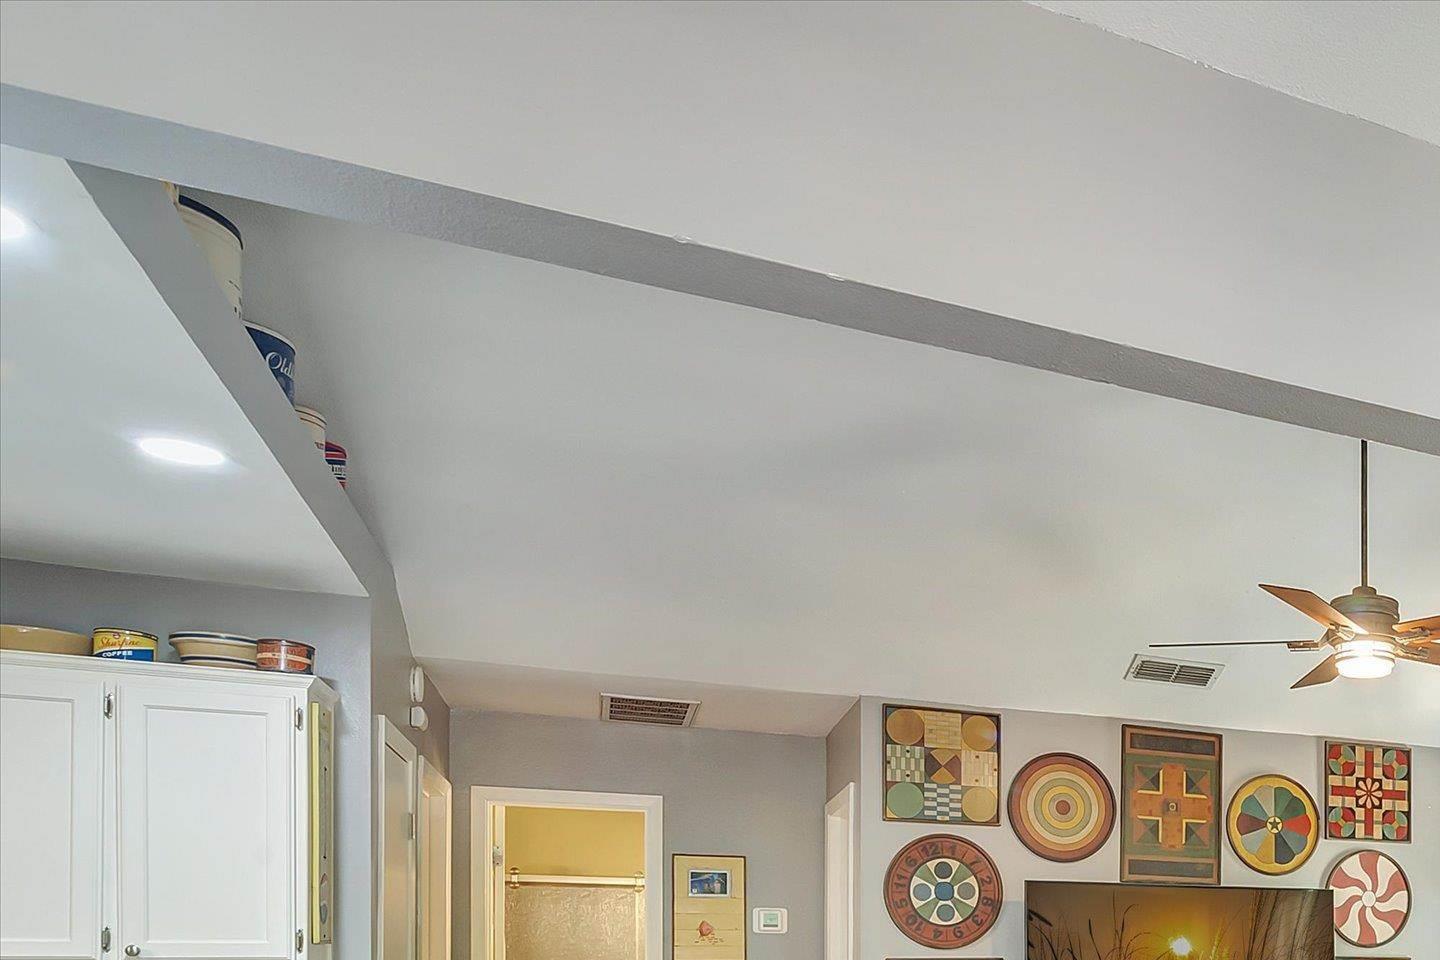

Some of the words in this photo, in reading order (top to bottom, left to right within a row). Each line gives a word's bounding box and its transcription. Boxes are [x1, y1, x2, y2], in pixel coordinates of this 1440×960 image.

[102, 650, 133, 658] COFFEE
[921, 844, 940, 857] 12
[980, 875, 992, 887] 2
[981, 896, 993, 906] 8
[972, 914, 983, 926] 3
